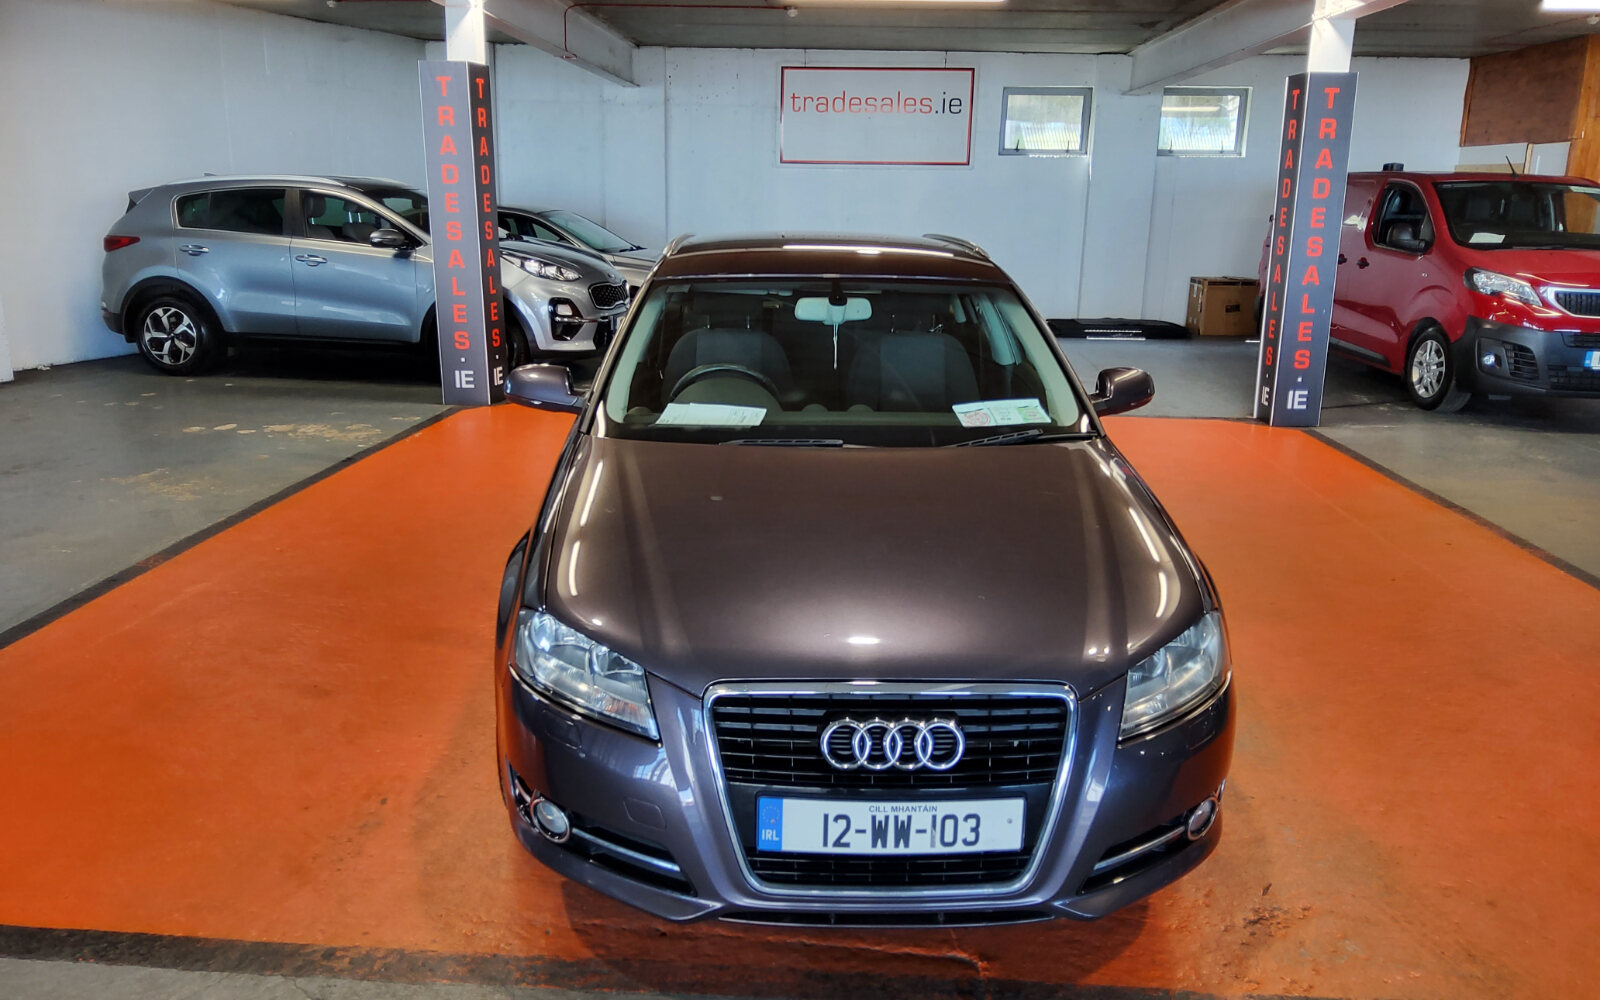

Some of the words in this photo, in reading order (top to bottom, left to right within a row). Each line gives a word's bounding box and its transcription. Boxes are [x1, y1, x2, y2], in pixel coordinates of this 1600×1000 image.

[790, 90, 962, 114] tradesales.ie
[436, 76, 475, 388] TRADESALES.IE
[475, 78, 504, 385] TRADESALES.IE
[1261, 89, 1300, 406] TRADESALES.IE
[1286, 88, 1340, 410] TRADESALES.IE
[761, 829, 779, 841] IRL
[822, 813, 981, 848] 12-WW-103
[868, 805, 889, 813] CILL
[890, 804, 938, 813] MHANTÁIN
